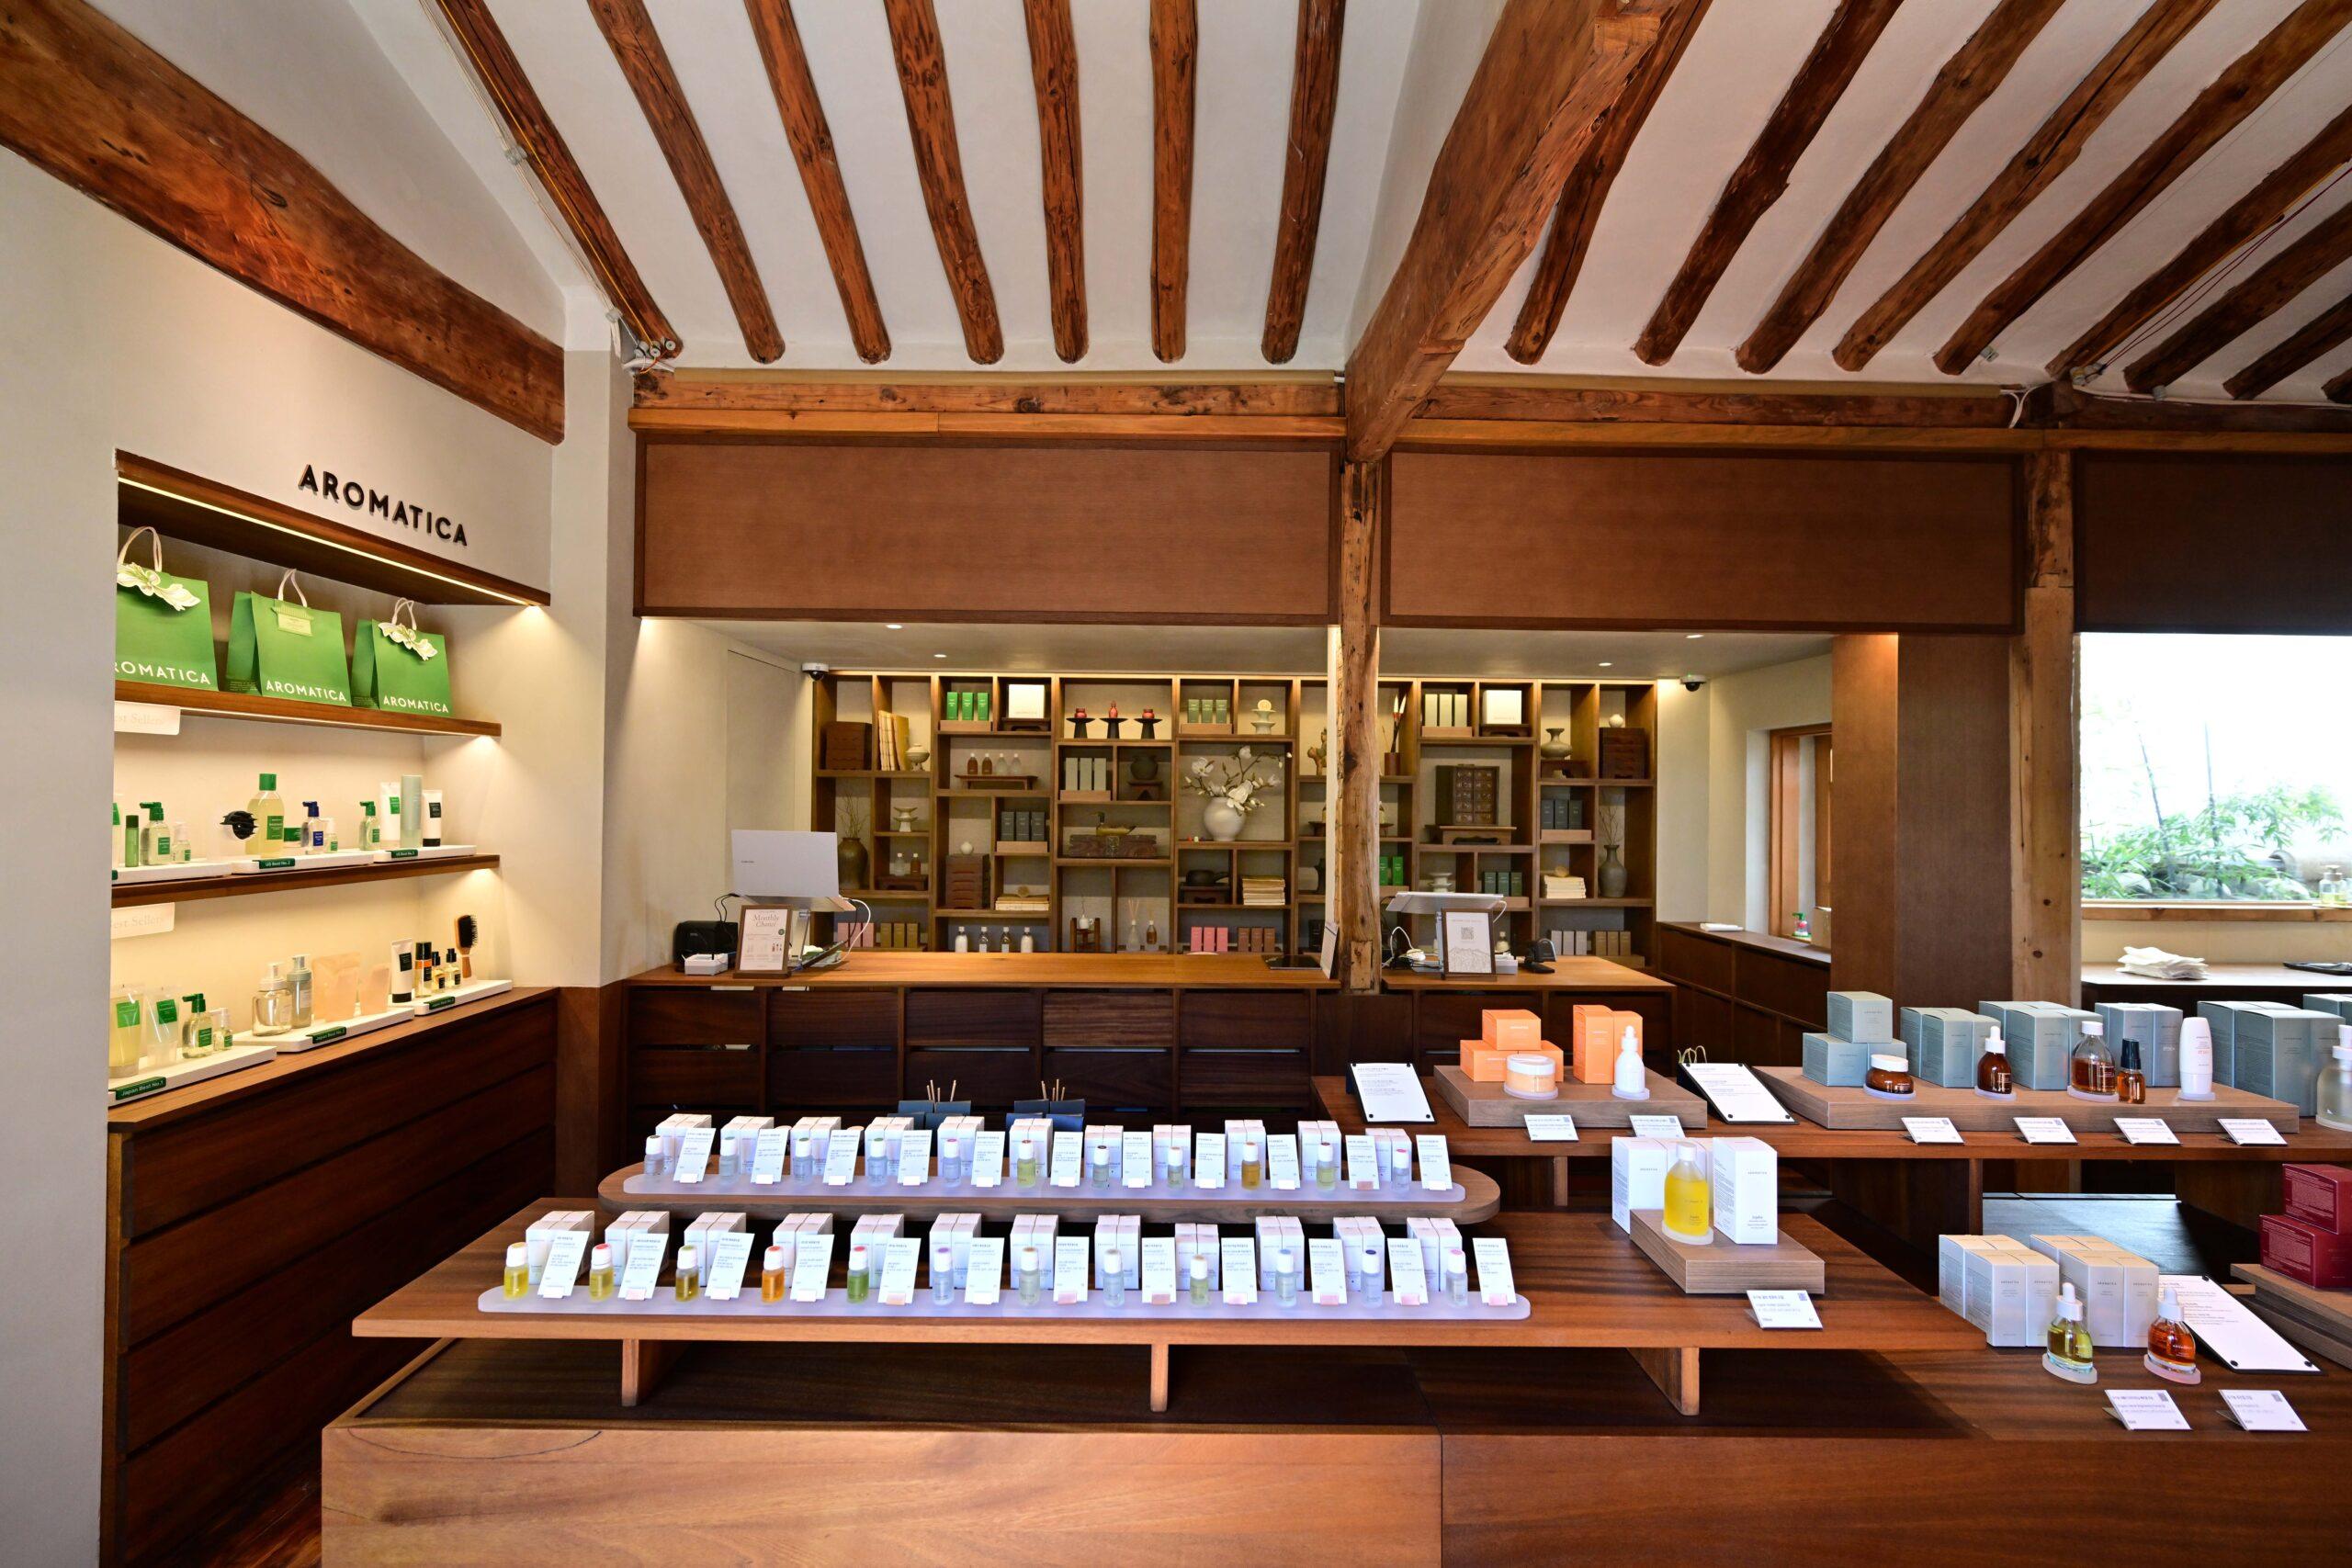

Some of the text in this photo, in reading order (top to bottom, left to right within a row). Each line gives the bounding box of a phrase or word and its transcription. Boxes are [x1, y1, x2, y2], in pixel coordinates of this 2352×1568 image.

[298, 464, 468, 546] AROMATICA
[266, 680, 347, 702] AROMATICA
[383, 695, 449, 713] AROMATICA
[121, 1088, 138, 1096] Japan
